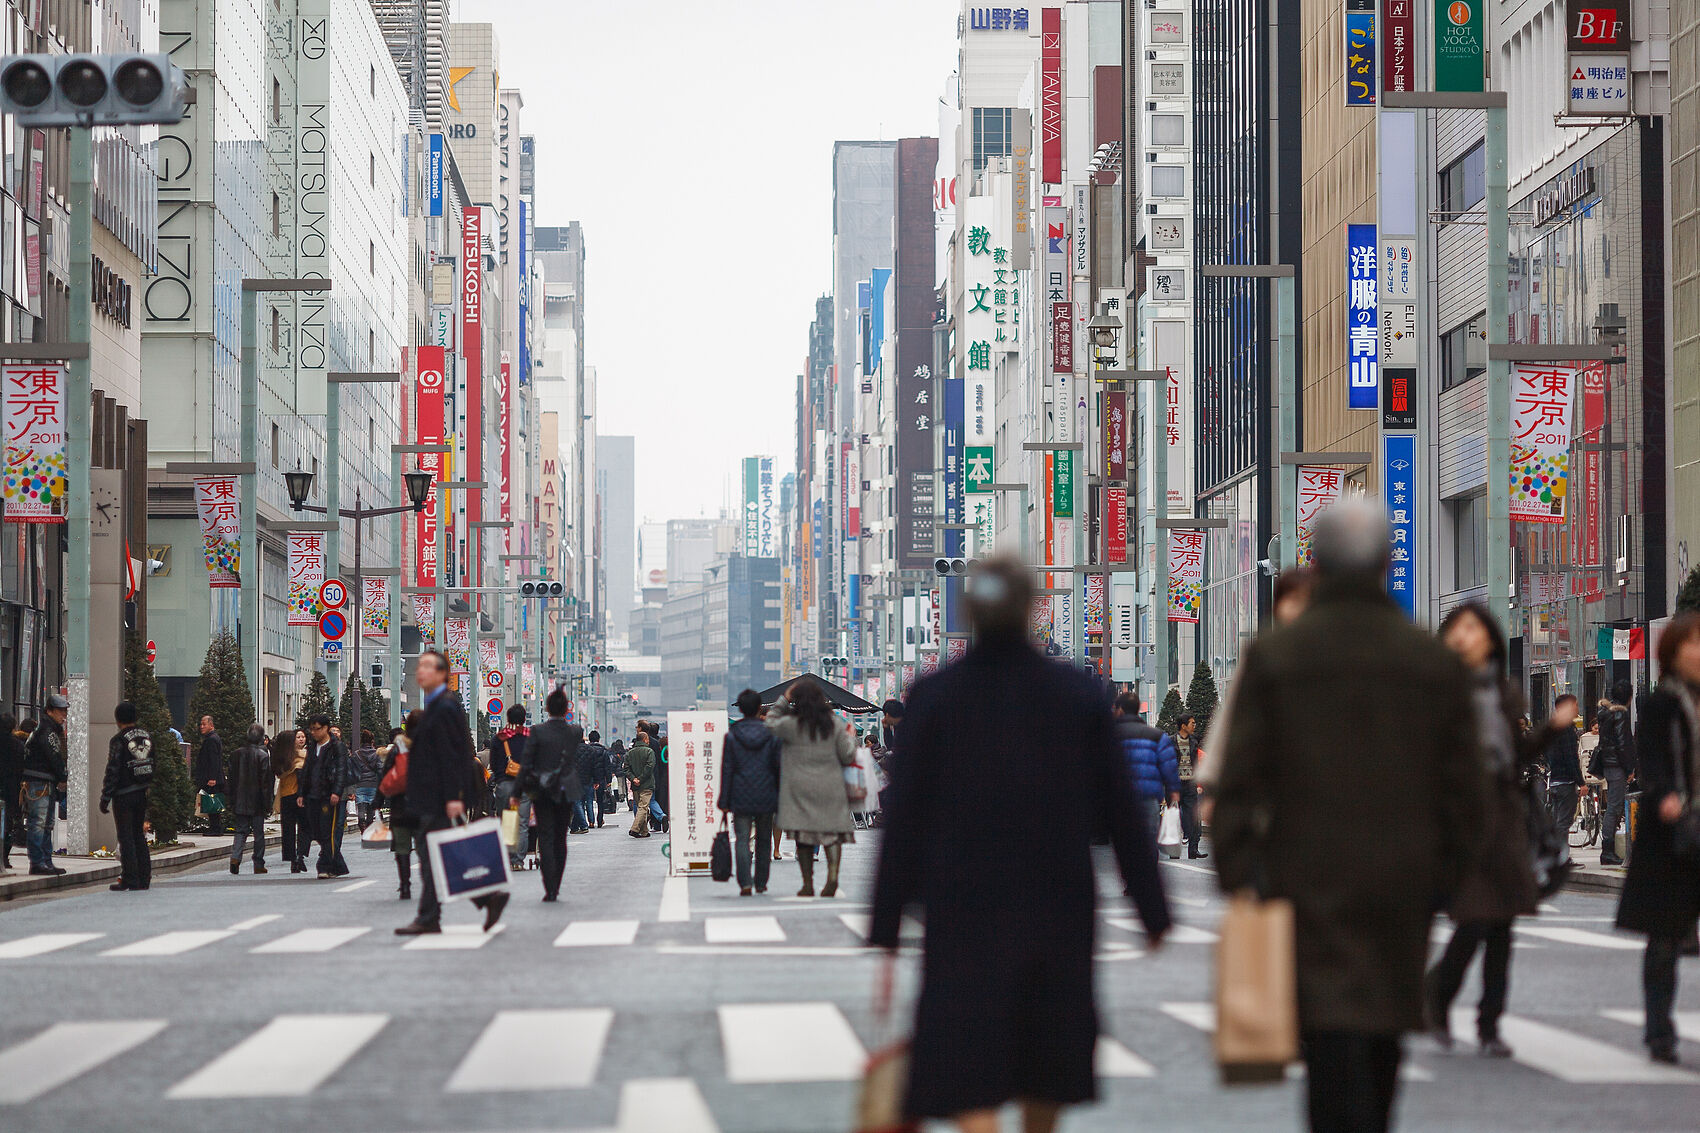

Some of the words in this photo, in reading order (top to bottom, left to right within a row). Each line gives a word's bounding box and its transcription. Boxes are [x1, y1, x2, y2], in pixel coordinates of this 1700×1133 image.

[1443, 35, 1477, 46] YOGA
[1447, 26, 1472, 36] HOT
[1573, 12, 1624, 40] B1F
[1349, 28, 1371, 99] こなつ
[1588, 67, 1627, 81] 明治屋
[1159, 79, 1177, 87] 美容室
[1571, 86, 1627, 100] 銀座ビル
[1043, 67, 1060, 144] TAMAYA
[432, 151, 441, 199] Panasonic
[465, 214, 478, 323] MITSUKOSHI
[968, 224, 991, 371] 教文館
[993, 246, 1008, 343] 教文館ビル
[438, 311, 447, 347] トップス
[1350, 246, 1377, 388] 洋服の青山
[1405, 305, 1414, 338] ELITE
[1383, 311, 1394, 363] Network.
[30, 368, 59, 425] 東京
[1539, 369, 1570, 426] 東京
[6, 370, 34, 467] マラソン
[1511, 369, 1540, 465] マラソン
[30, 433, 61, 444] 2011
[1535, 433, 1566, 446] 2011
[968, 453, 991, 485] 本
[197, 482, 222, 549] マラソン
[215, 480, 237, 520] 東京
[1117, 490, 1126, 541] FEBBRAIO
[290, 537, 306, 594] マラソン
[305, 536, 321, 569] 東京
[1169, 533, 1188, 589] マラソン
[1185, 533, 1203, 566] 東京
[374, 579, 386, 600] 東京
[1182, 569, 1202, 577] 2011
[325, 588, 341, 597] 50
[366, 579, 377, 615] マラソン
[422, 597, 431, 614] 東京
[456, 620, 468, 639] 東京
[703, 740, 715, 824] 道路上での人寄せ行為
